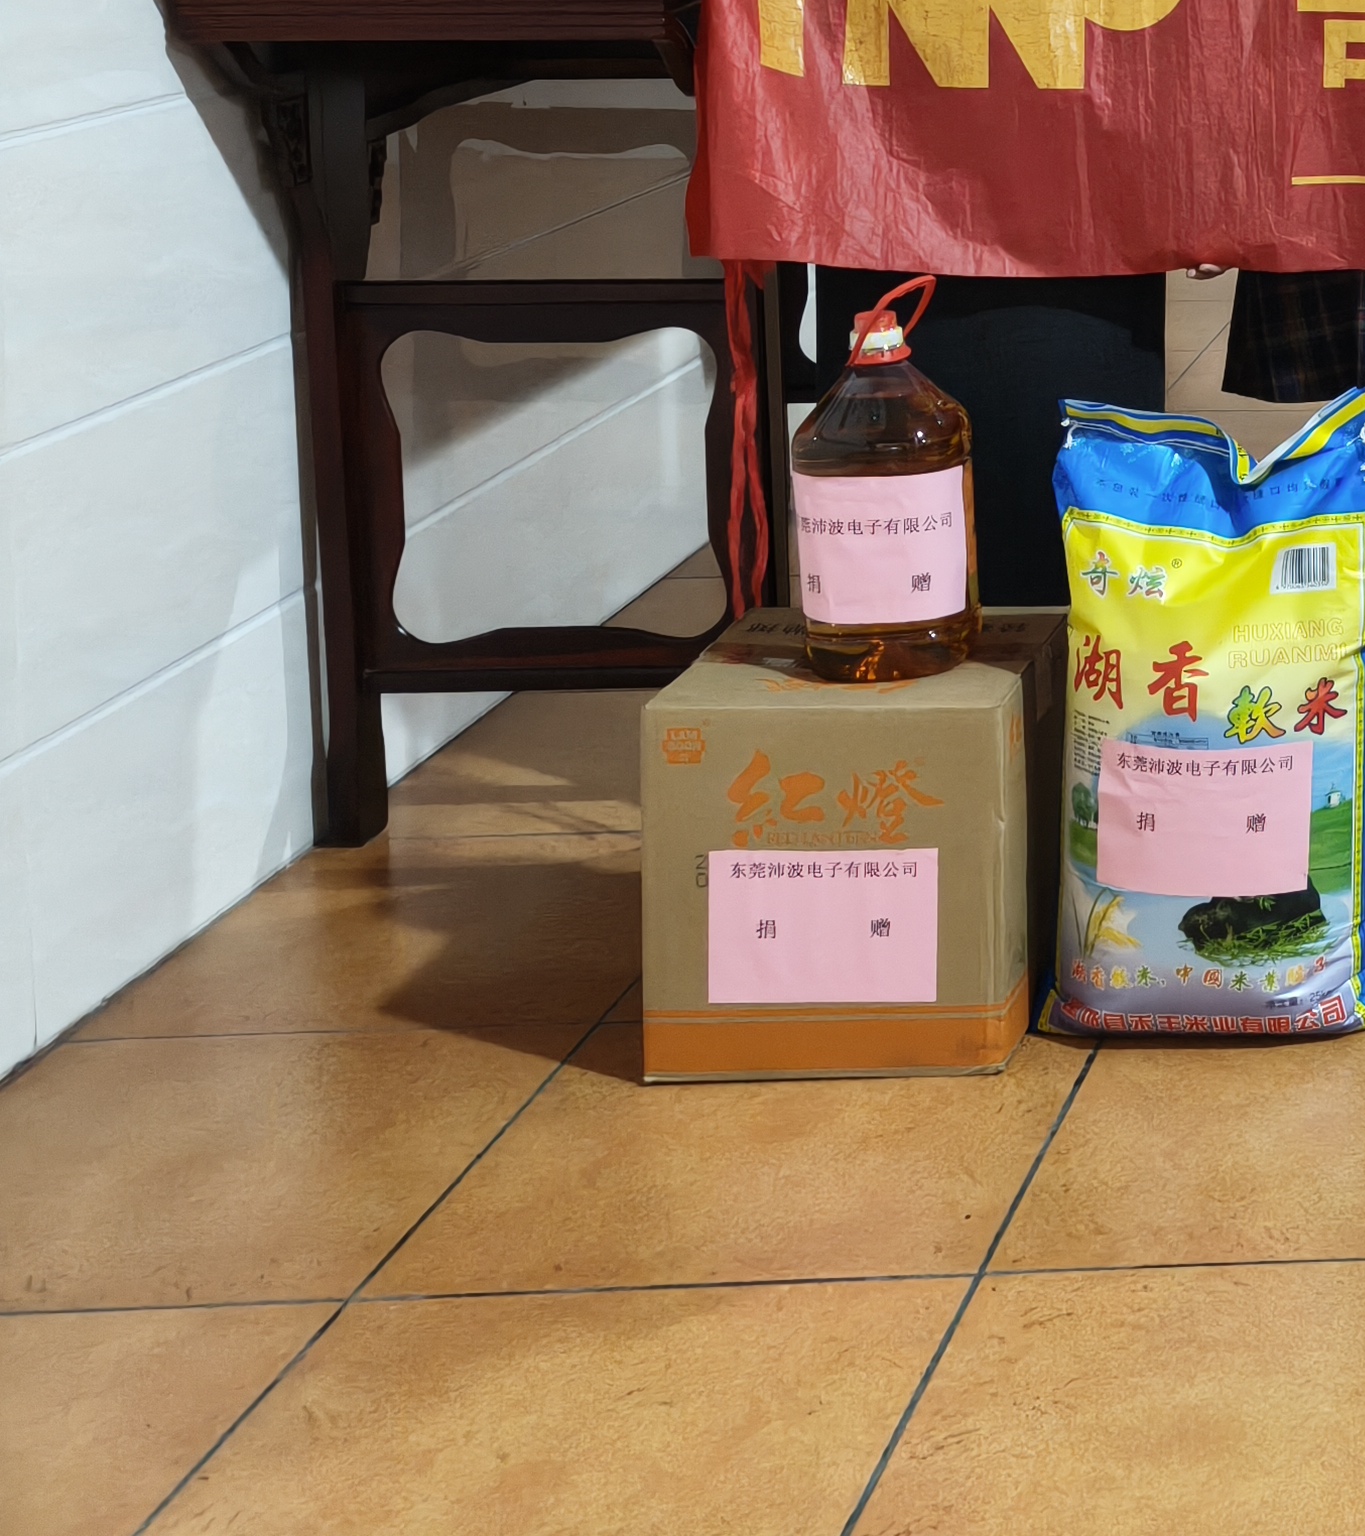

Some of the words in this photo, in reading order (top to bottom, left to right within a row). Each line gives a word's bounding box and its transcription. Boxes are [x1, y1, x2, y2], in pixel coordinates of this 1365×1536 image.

[801, 512, 953, 537] 莞沛波电子有限公司
[807, 573, 822, 594] 捐
[910, 572, 931, 593] 赠
[1233, 617, 1344, 644] HUXIANG
[1116, 752, 1294, 778] 东莞沛波电子有限公司
[1136, 812, 1156, 832] 捐
[1245, 814, 1267, 834] 赠
[729, 860, 919, 880] 东莞沛波电子有限公司
[755, 919, 777, 940] 捐
[869, 919, 891, 939] 赠
